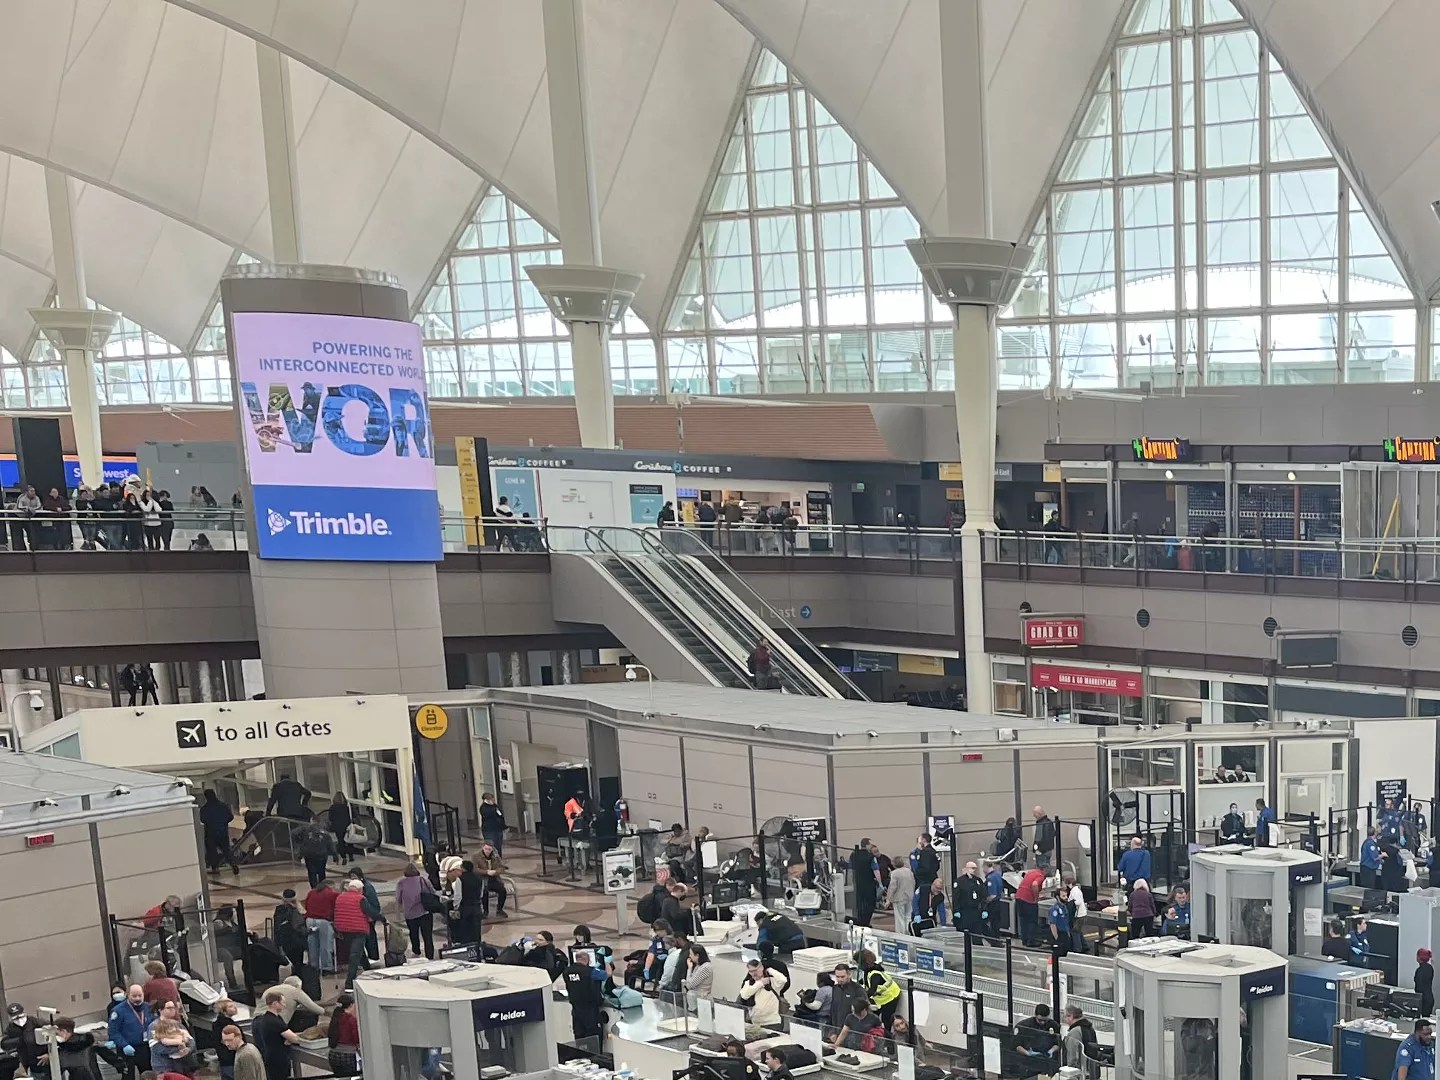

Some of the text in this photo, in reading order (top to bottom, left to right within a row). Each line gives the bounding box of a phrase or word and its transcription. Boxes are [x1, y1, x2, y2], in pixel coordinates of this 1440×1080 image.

[312, 342, 414, 361] POWERING THE
[258, 358, 394, 377] INTERCONNECTED
[240, 381, 433, 458] WOR
[1142, 436, 1177, 460] CANTINA
[1395, 436, 1436, 461] CANTINA
[526, 459, 561, 467] COFFEE
[633, 461, 720, 474] Caribou COFFEE
[214, 720, 332, 742] to all Gates
[568, 973, 581, 982] TSA
[500, 1010, 526, 1021] leidos
